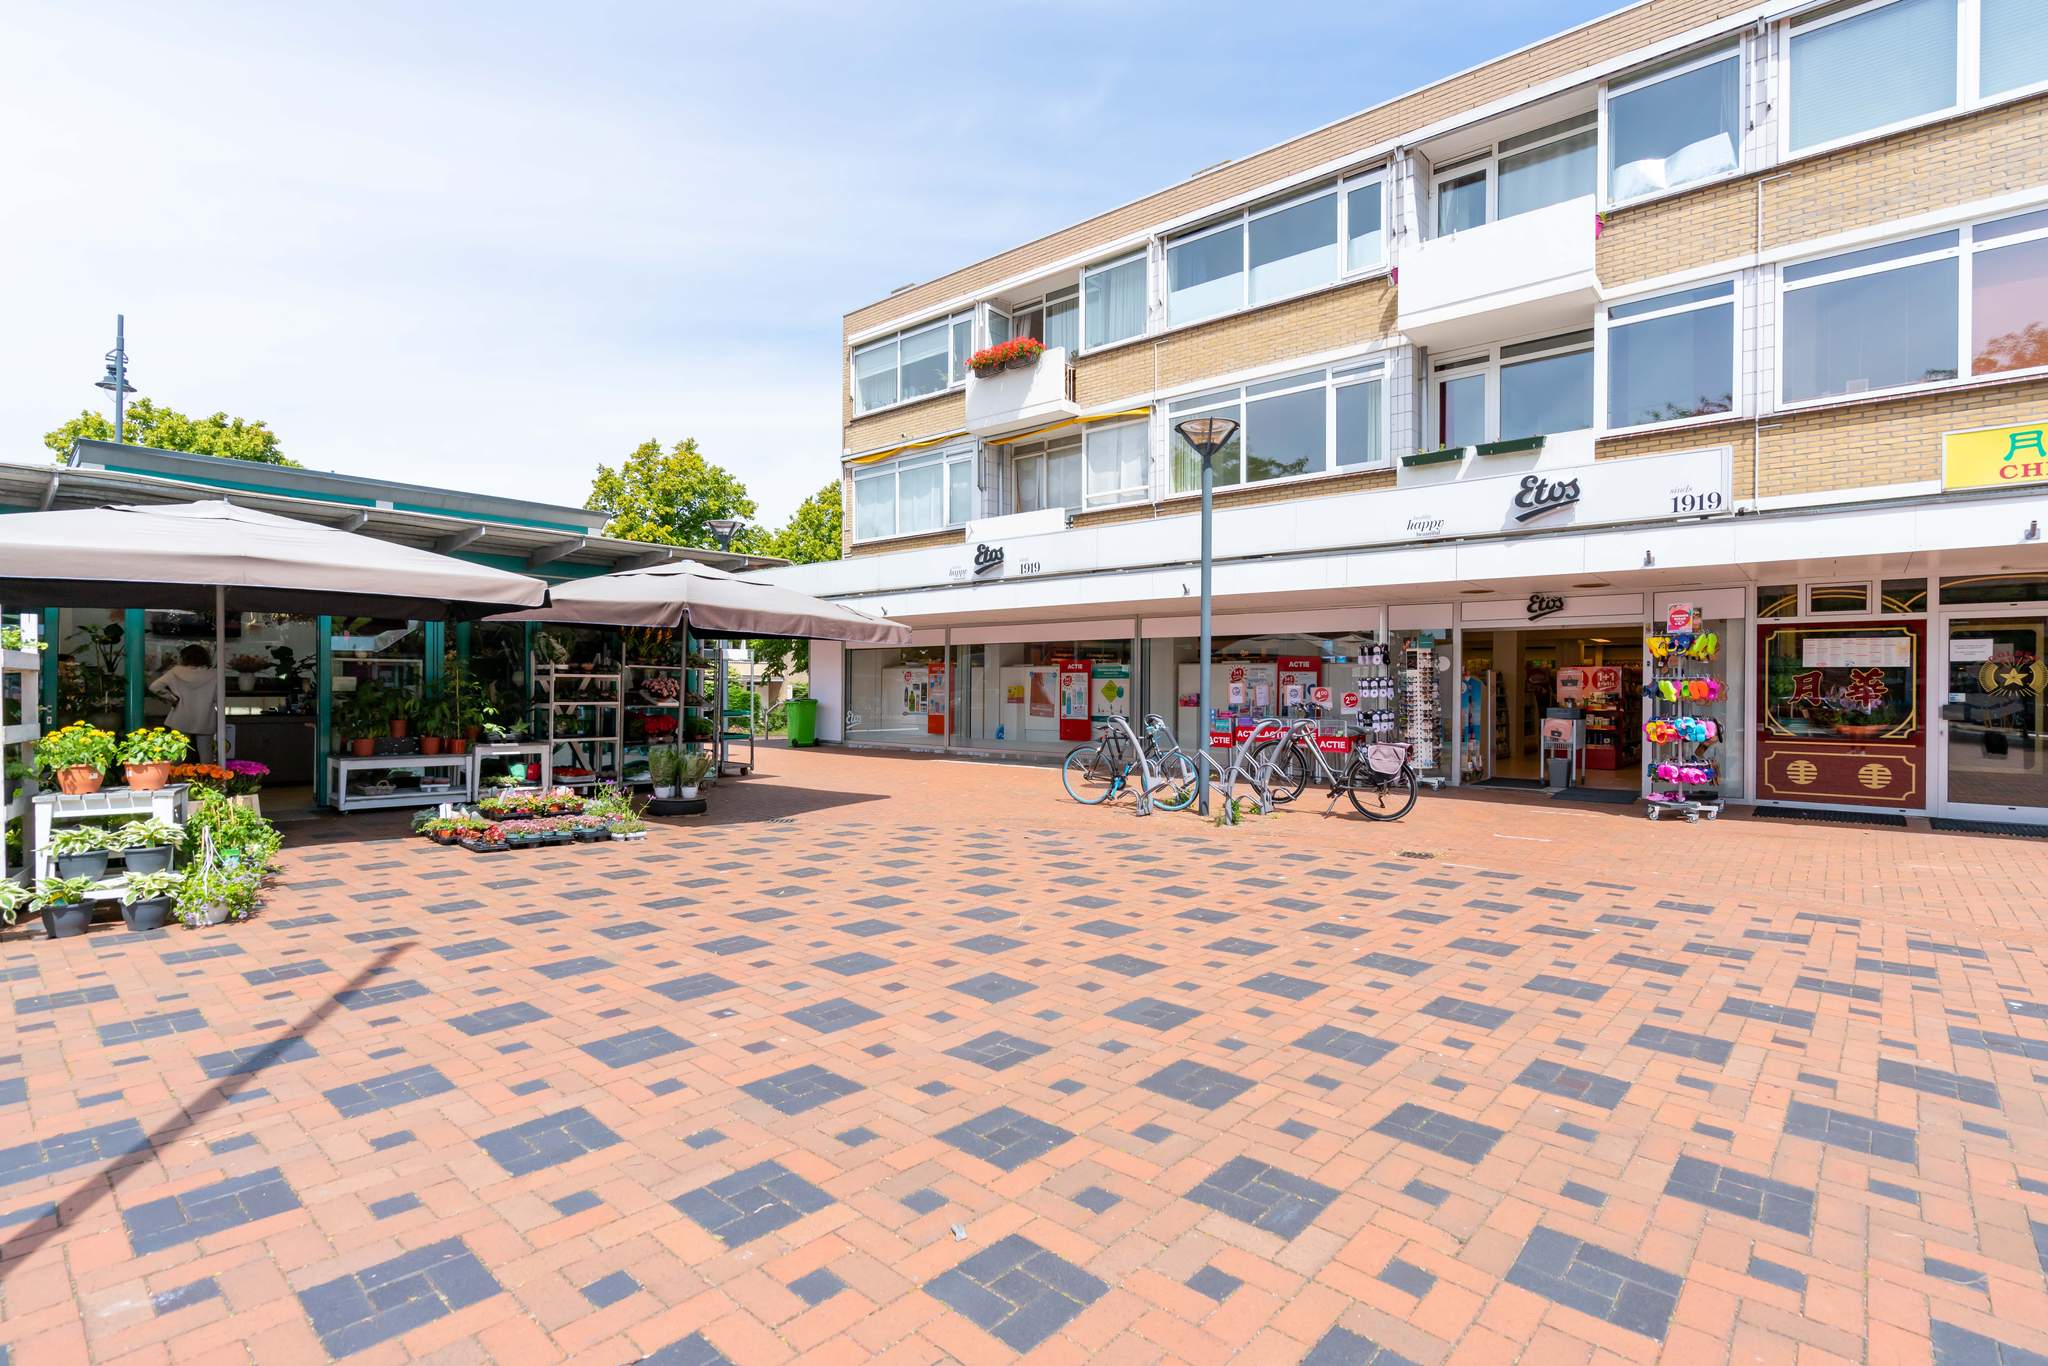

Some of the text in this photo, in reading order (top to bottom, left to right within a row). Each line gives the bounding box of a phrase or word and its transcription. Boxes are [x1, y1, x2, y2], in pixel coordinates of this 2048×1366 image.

[1515, 475, 1581, 522] Etos
[1670, 491, 1722, 513] 1919
[1406, 519, 1444, 532] happy
[974, 543, 1004, 575] Etos
[1019, 561, 1041, 575] 1919
[1526, 594, 1564, 622] Etos
[1288, 660, 1310, 668] ACTIE
[1597, 672, 1615, 682] 1+1
[1319, 741, 1346, 749] ACTIE
